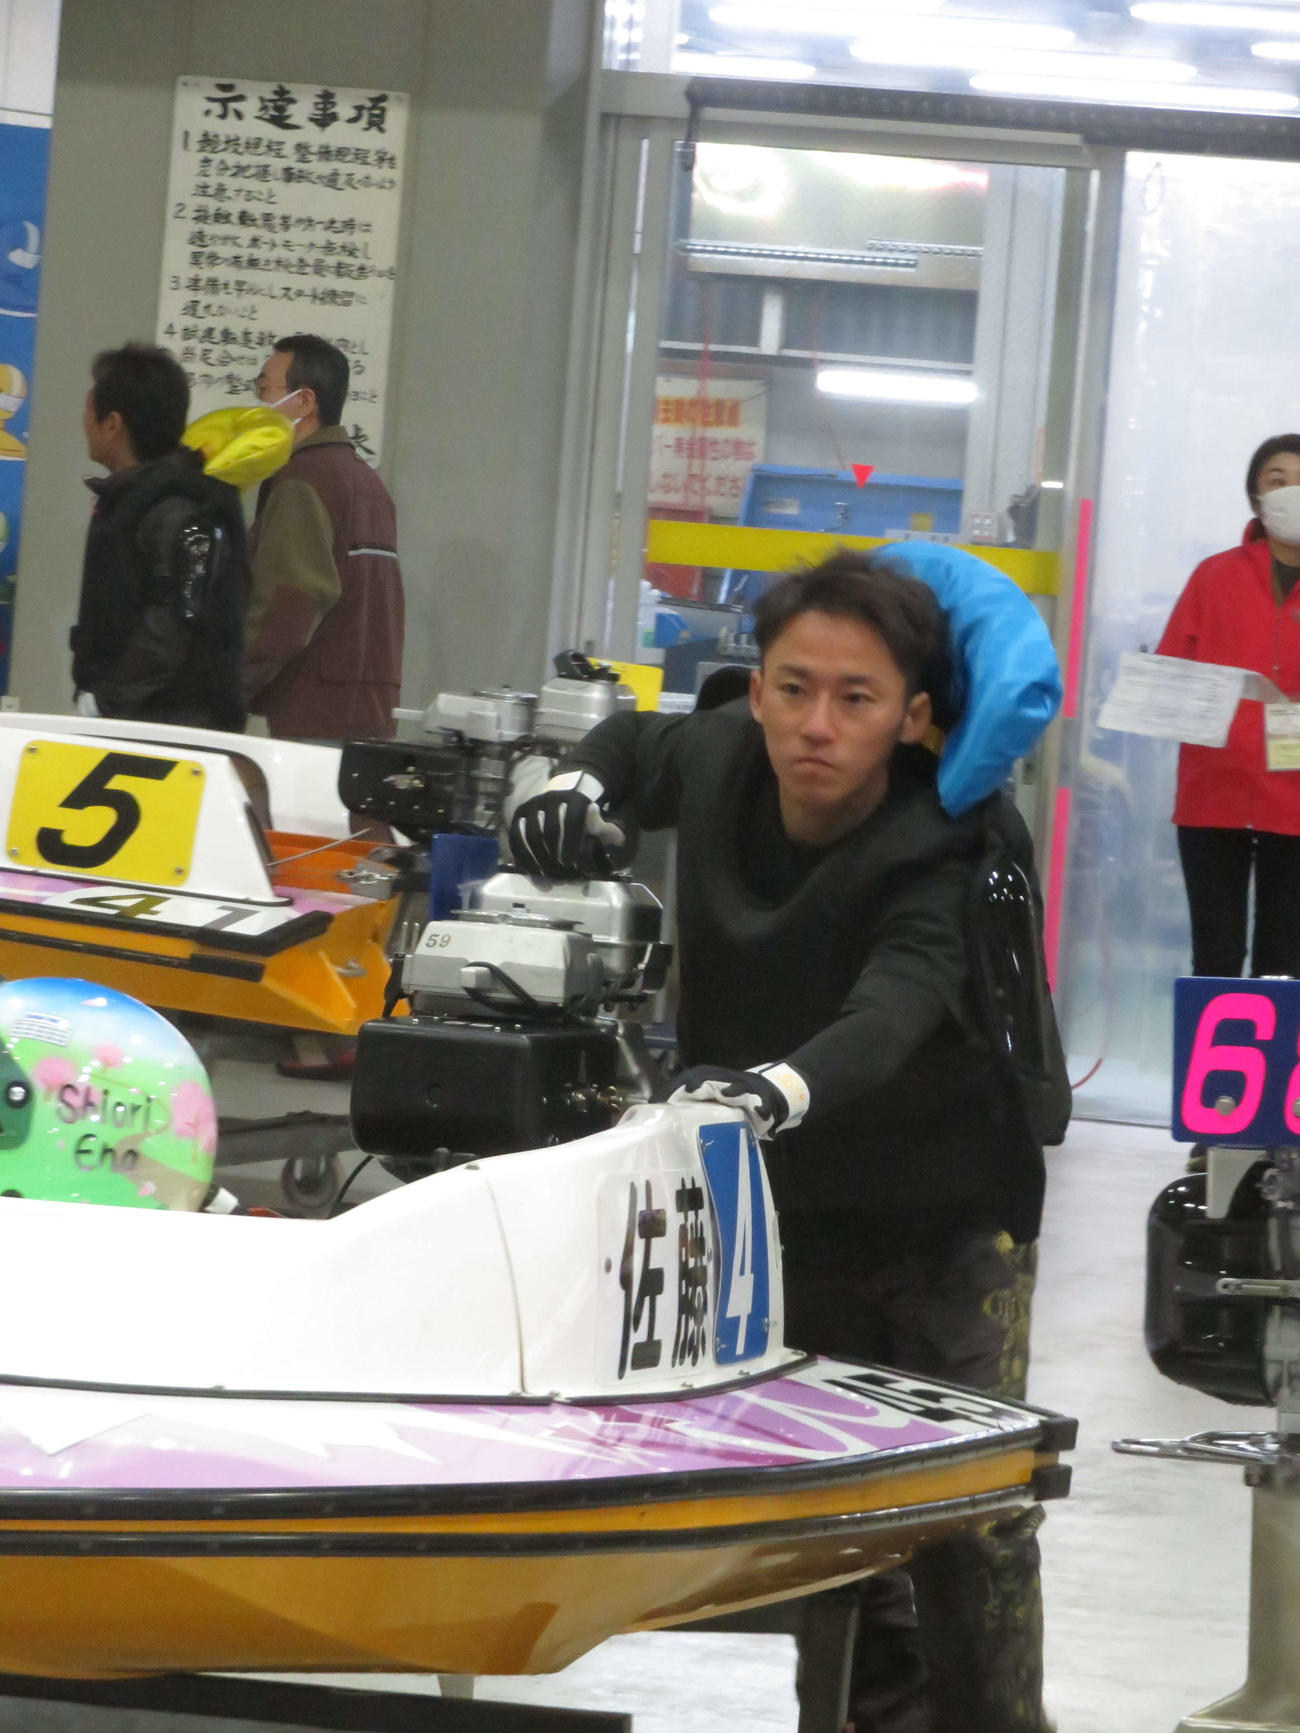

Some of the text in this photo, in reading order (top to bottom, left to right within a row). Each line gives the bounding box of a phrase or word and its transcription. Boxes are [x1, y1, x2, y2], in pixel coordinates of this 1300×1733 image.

[202, 82, 389, 134] 示達事項
[172, 203, 187, 220] 2
[168, 275, 181, 291] 3
[163, 322, 178, 336] 4
[36, 752, 179, 869] 5
[425, 933, 452, 948] 59
[56, 1082, 153, 1134] Shiori
[725, 1127, 755, 1357] 4
[617, 1175, 708, 1381] 佐藤
